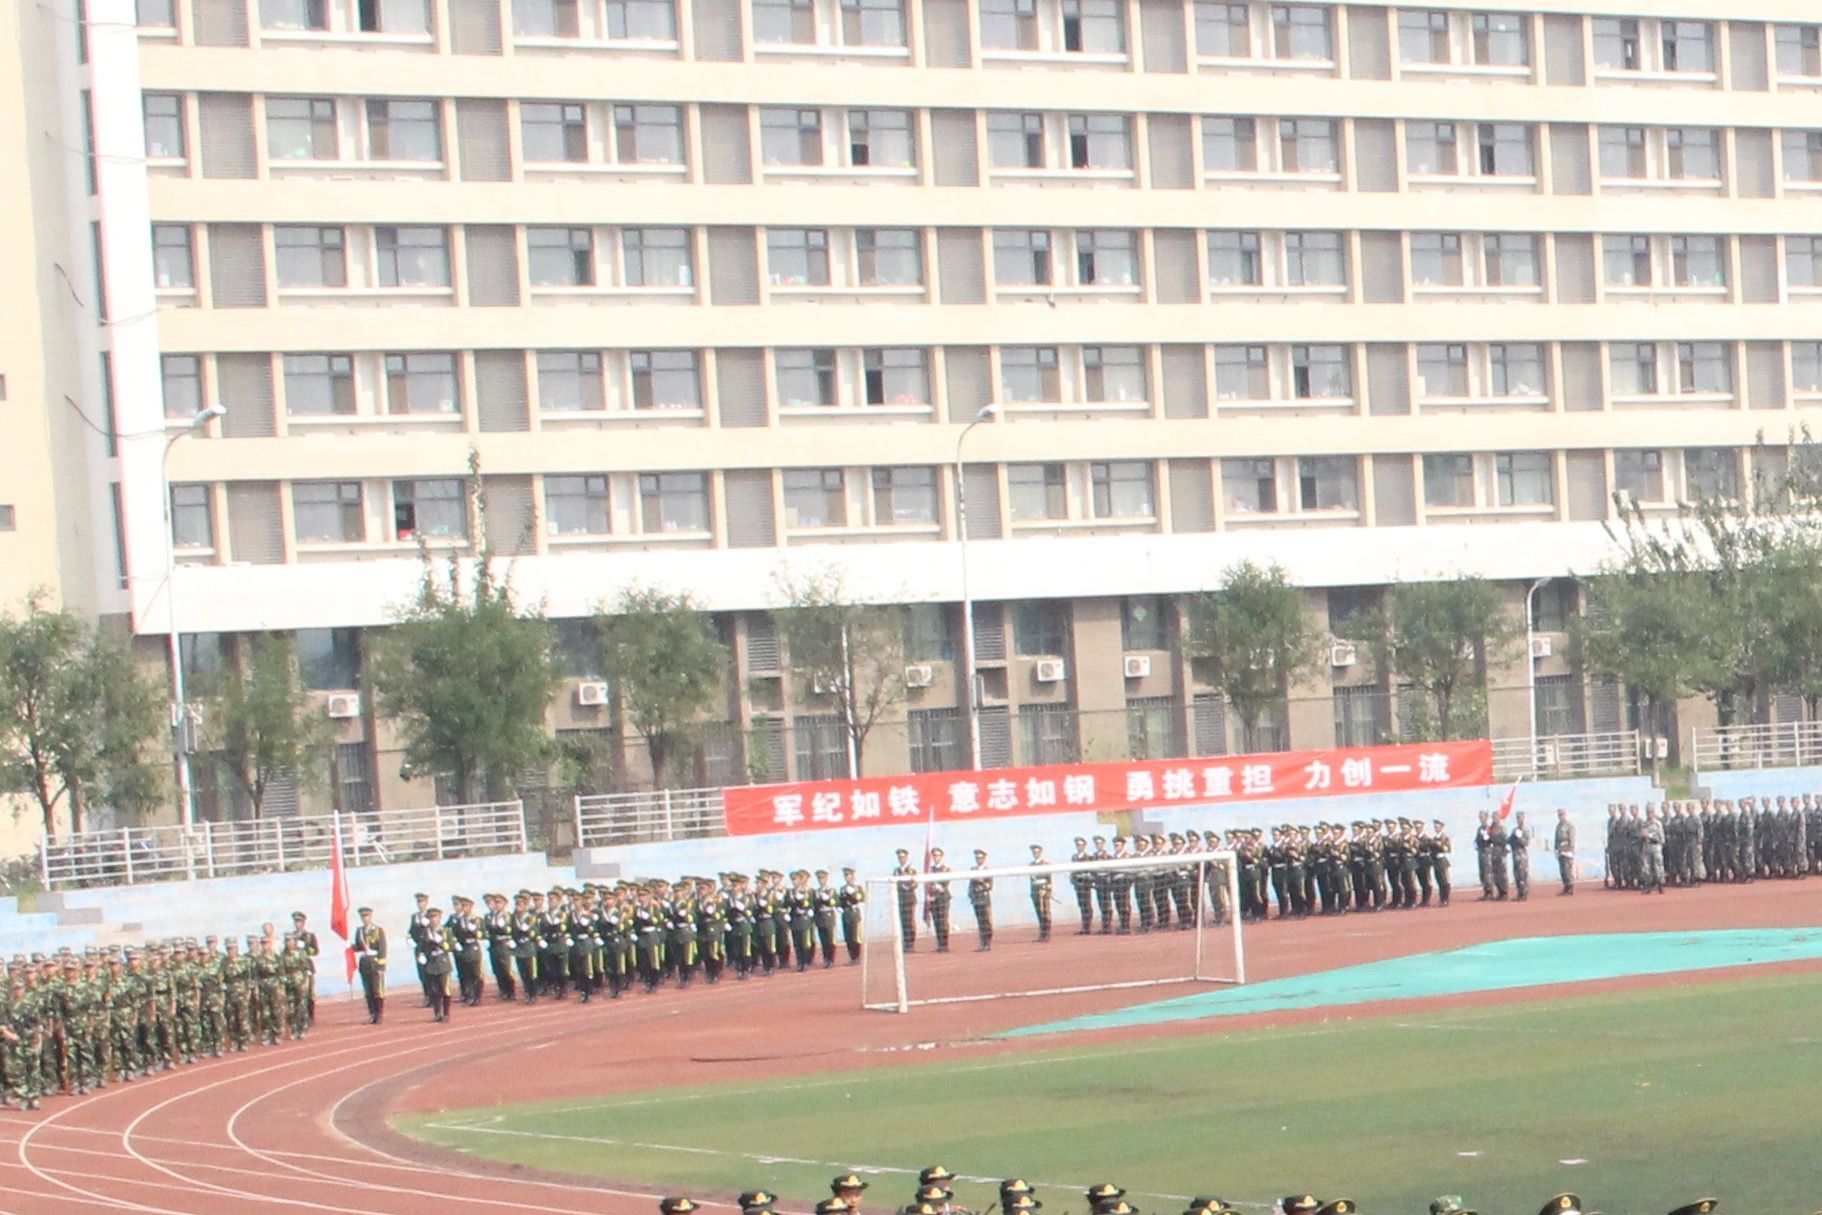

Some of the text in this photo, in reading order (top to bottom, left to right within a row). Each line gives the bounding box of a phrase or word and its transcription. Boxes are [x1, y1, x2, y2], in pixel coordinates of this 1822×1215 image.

[772, 752, 1450, 826] 军纪如铁 意志如钢 勇挑重担 力创一流
